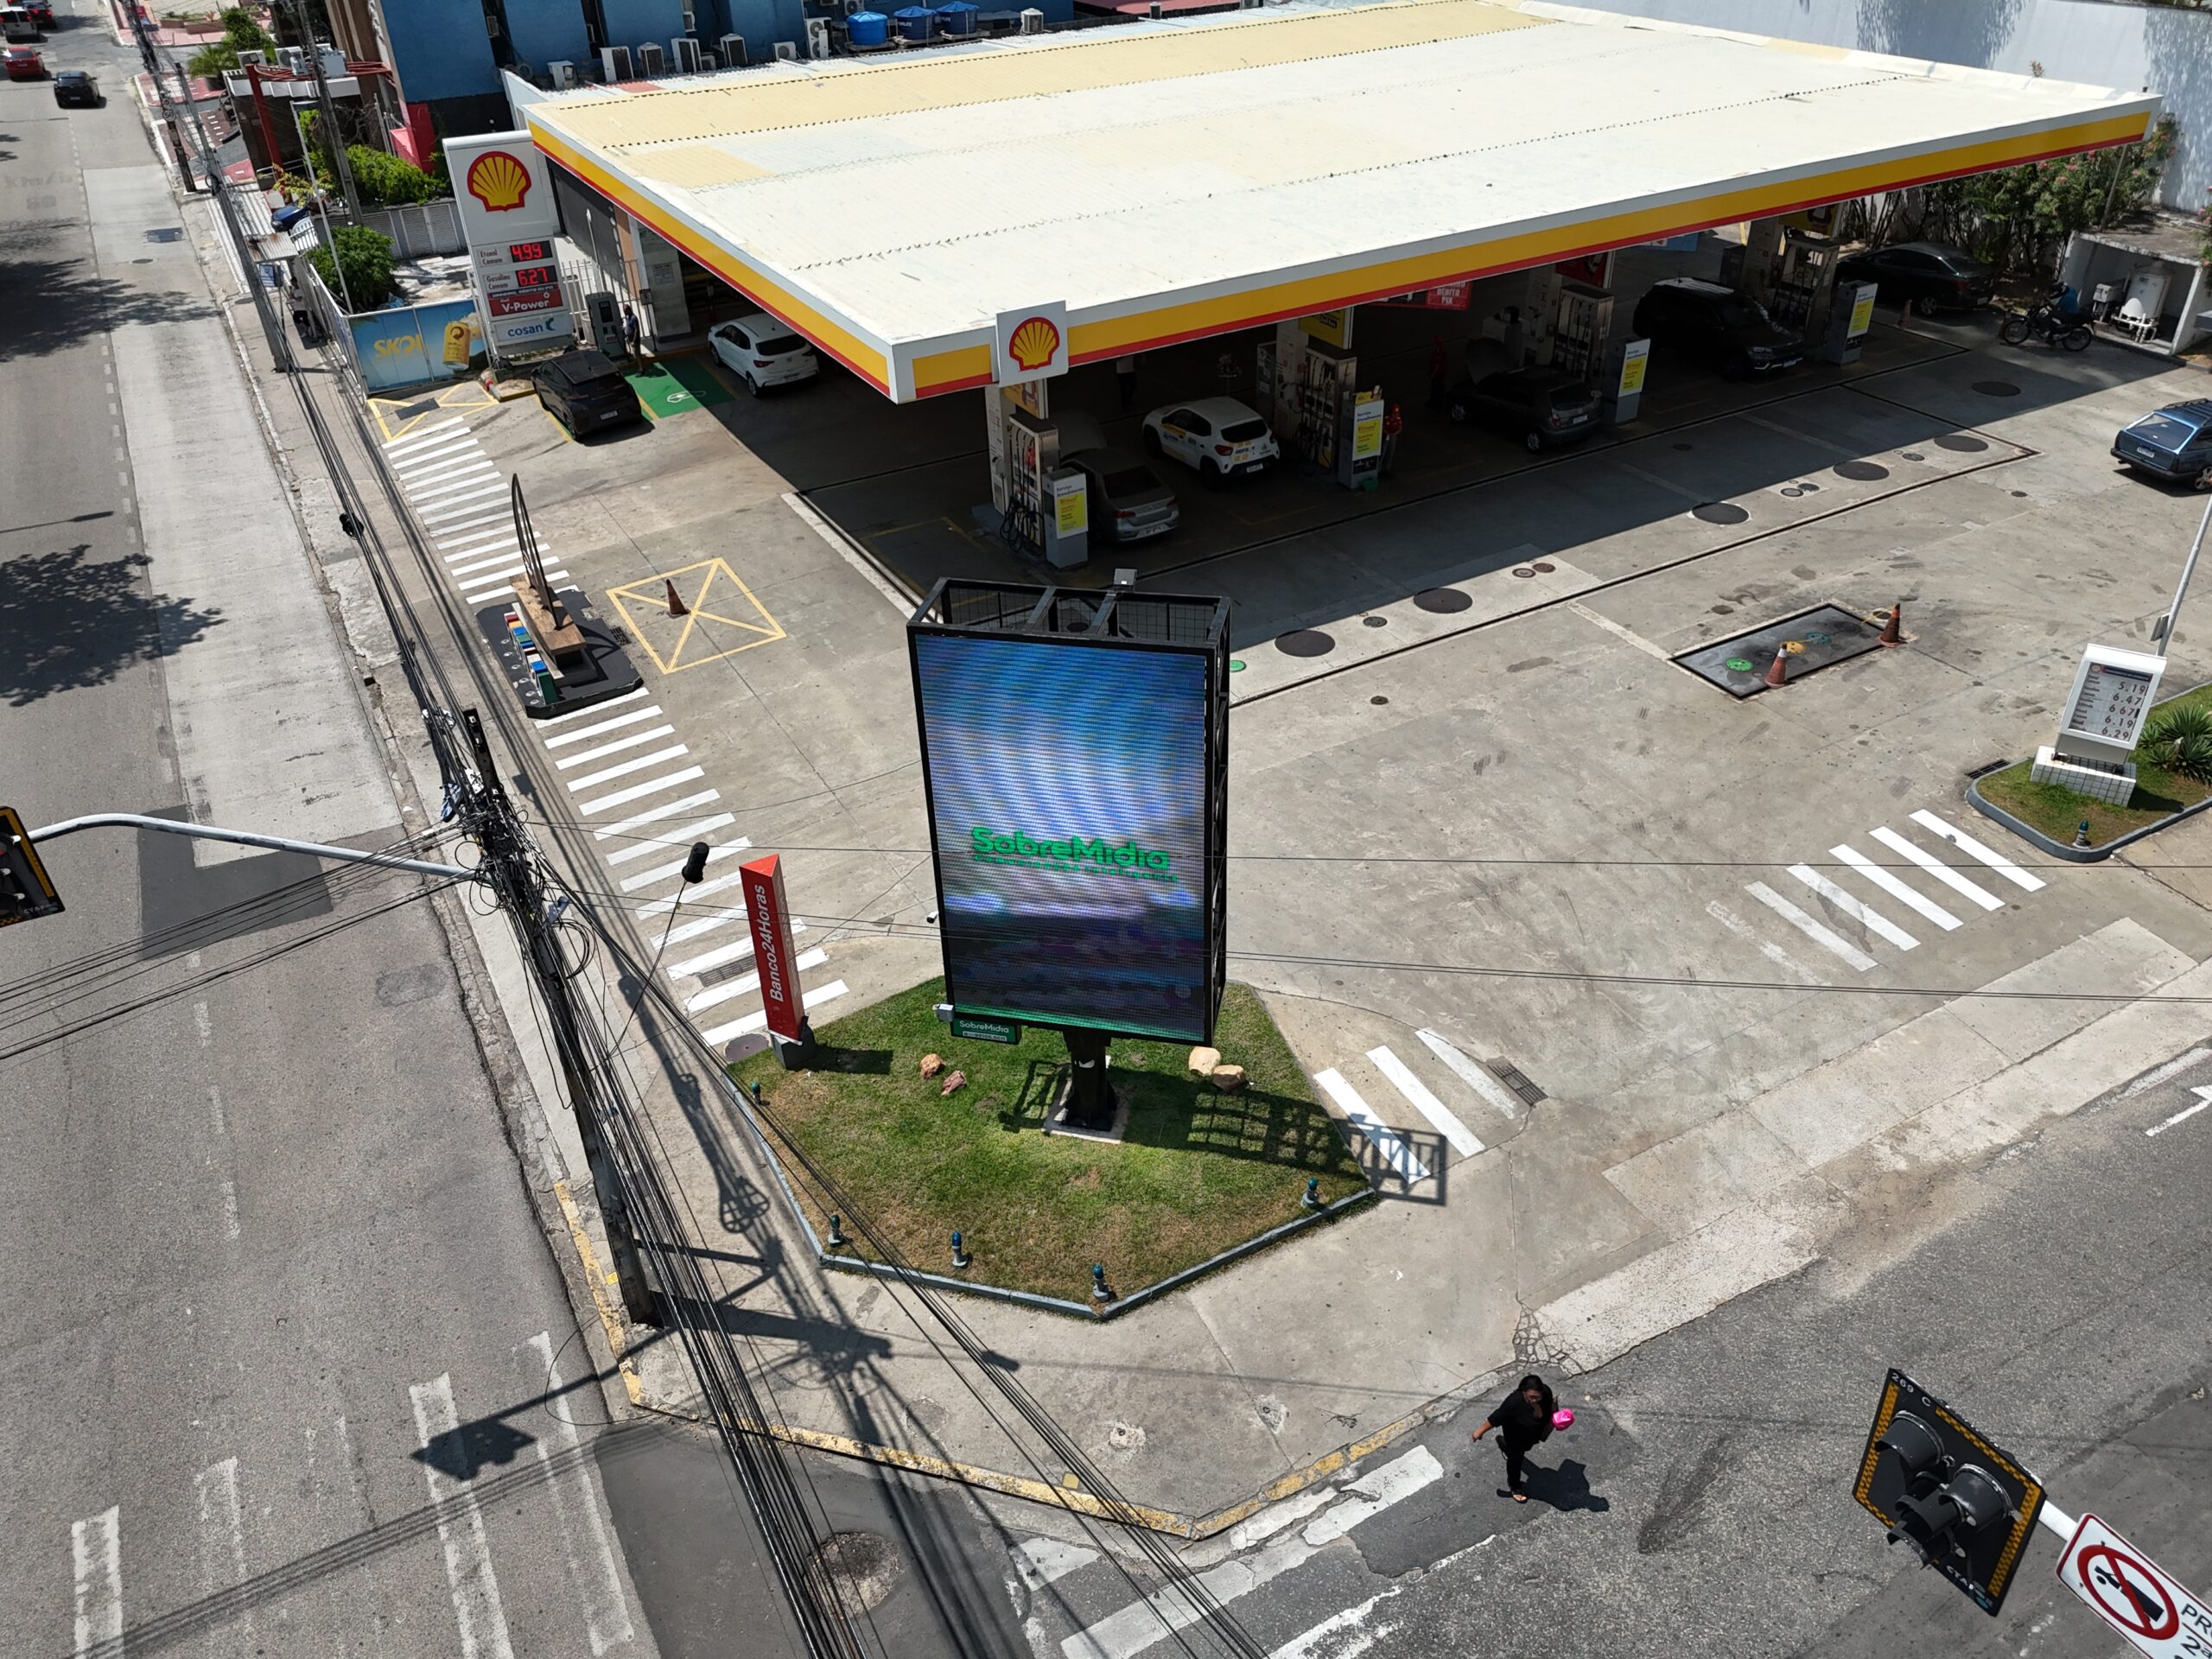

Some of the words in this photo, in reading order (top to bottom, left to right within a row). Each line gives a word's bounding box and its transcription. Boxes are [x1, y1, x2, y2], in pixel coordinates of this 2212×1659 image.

[512, 244, 543, 261] 4.99
[518, 267, 549, 288] 6.27
[501, 300, 550, 313] V-Power
[507, 324, 543, 337] cosan
[2118, 681, 2145, 695] 5.19
[2113, 692, 2142, 706] 6.47
[2105, 715, 2133, 728] 6.19
[2101, 727, 2129, 740] 6.29
[754, 884, 785, 1003] Banco24Horas
[1891, 1372, 1915, 1394] 269
[1921, 1396, 1931, 1407] C
[2181, 1603, 2212, 1638] PR
